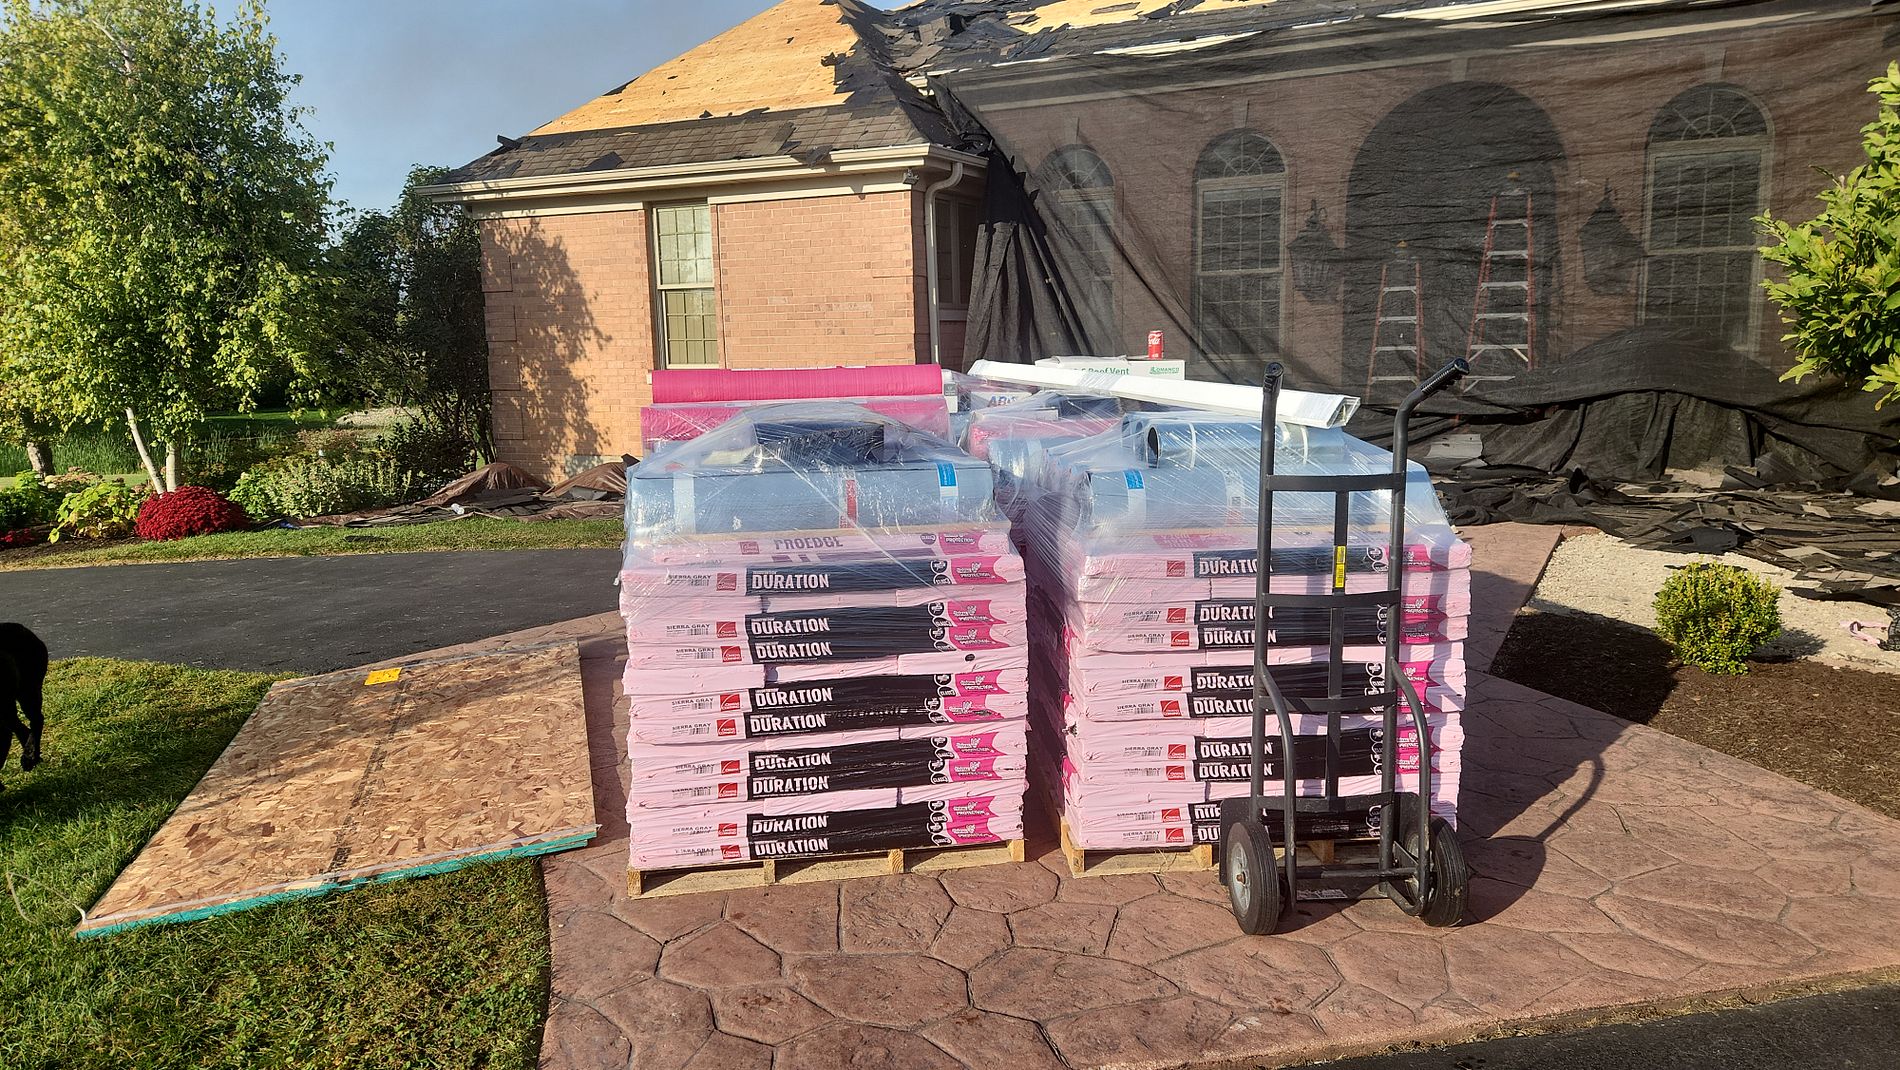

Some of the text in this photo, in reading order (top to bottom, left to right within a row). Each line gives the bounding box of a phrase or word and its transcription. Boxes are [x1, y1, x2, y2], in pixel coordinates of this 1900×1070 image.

[773, 536, 844, 550] PROEDGE
[752, 574, 829, 589] DURATION
[751, 618, 830, 635] DURATION
[1203, 629, 1277, 645] DURATIN
[755, 642, 832, 659] DURATION
[755, 688, 833, 707] DURATION
[751, 714, 826, 733] DURATION
[1201, 742, 1273, 758] DURATIN
[755, 753, 832, 771] DURATION
[1200, 763, 1273, 778] DURATIN
[752, 776, 829, 795] DURATION
[752, 816, 828, 834] DURATION
[755, 838, 829, 856] DURATION
